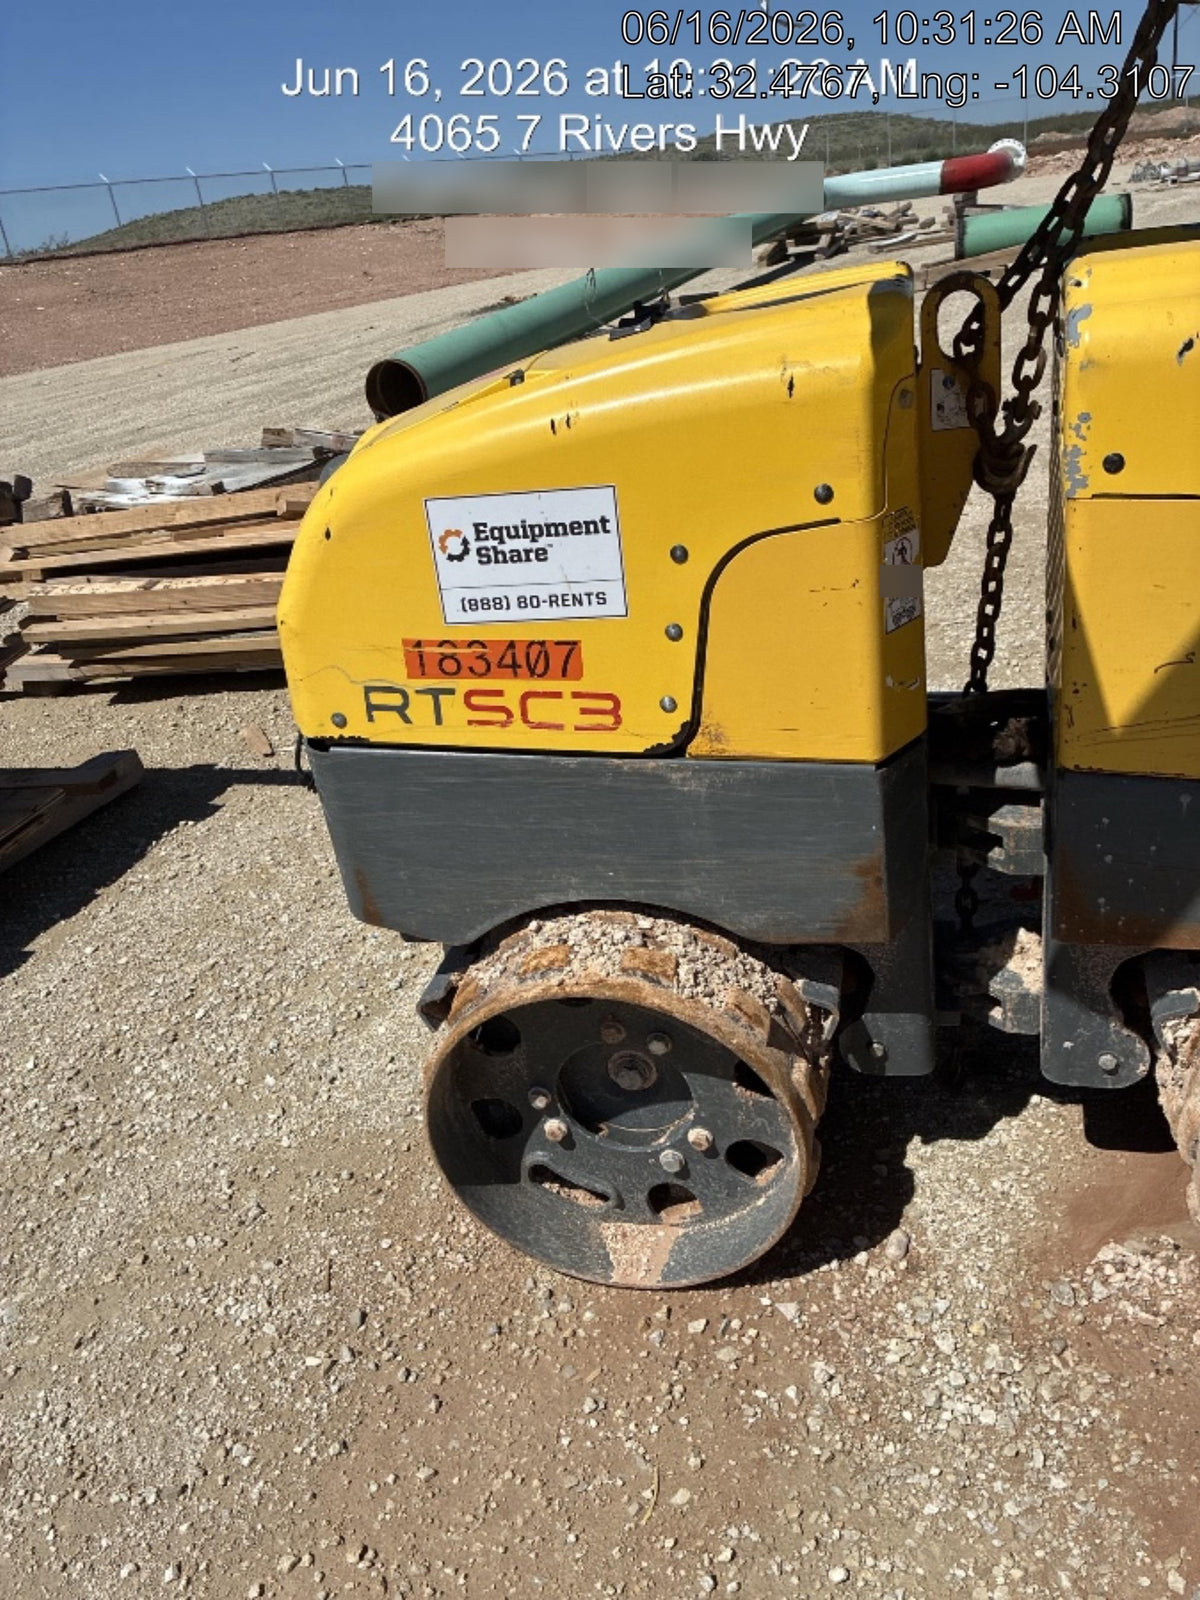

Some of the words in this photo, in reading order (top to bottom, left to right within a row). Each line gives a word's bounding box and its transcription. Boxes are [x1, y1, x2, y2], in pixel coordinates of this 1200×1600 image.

[472, 515, 611, 544] Equipment
[460, 594, 512, 613] (888)
[516, 591, 608, 610] 80-RENTS
[409, 639, 579, 679] 183407
